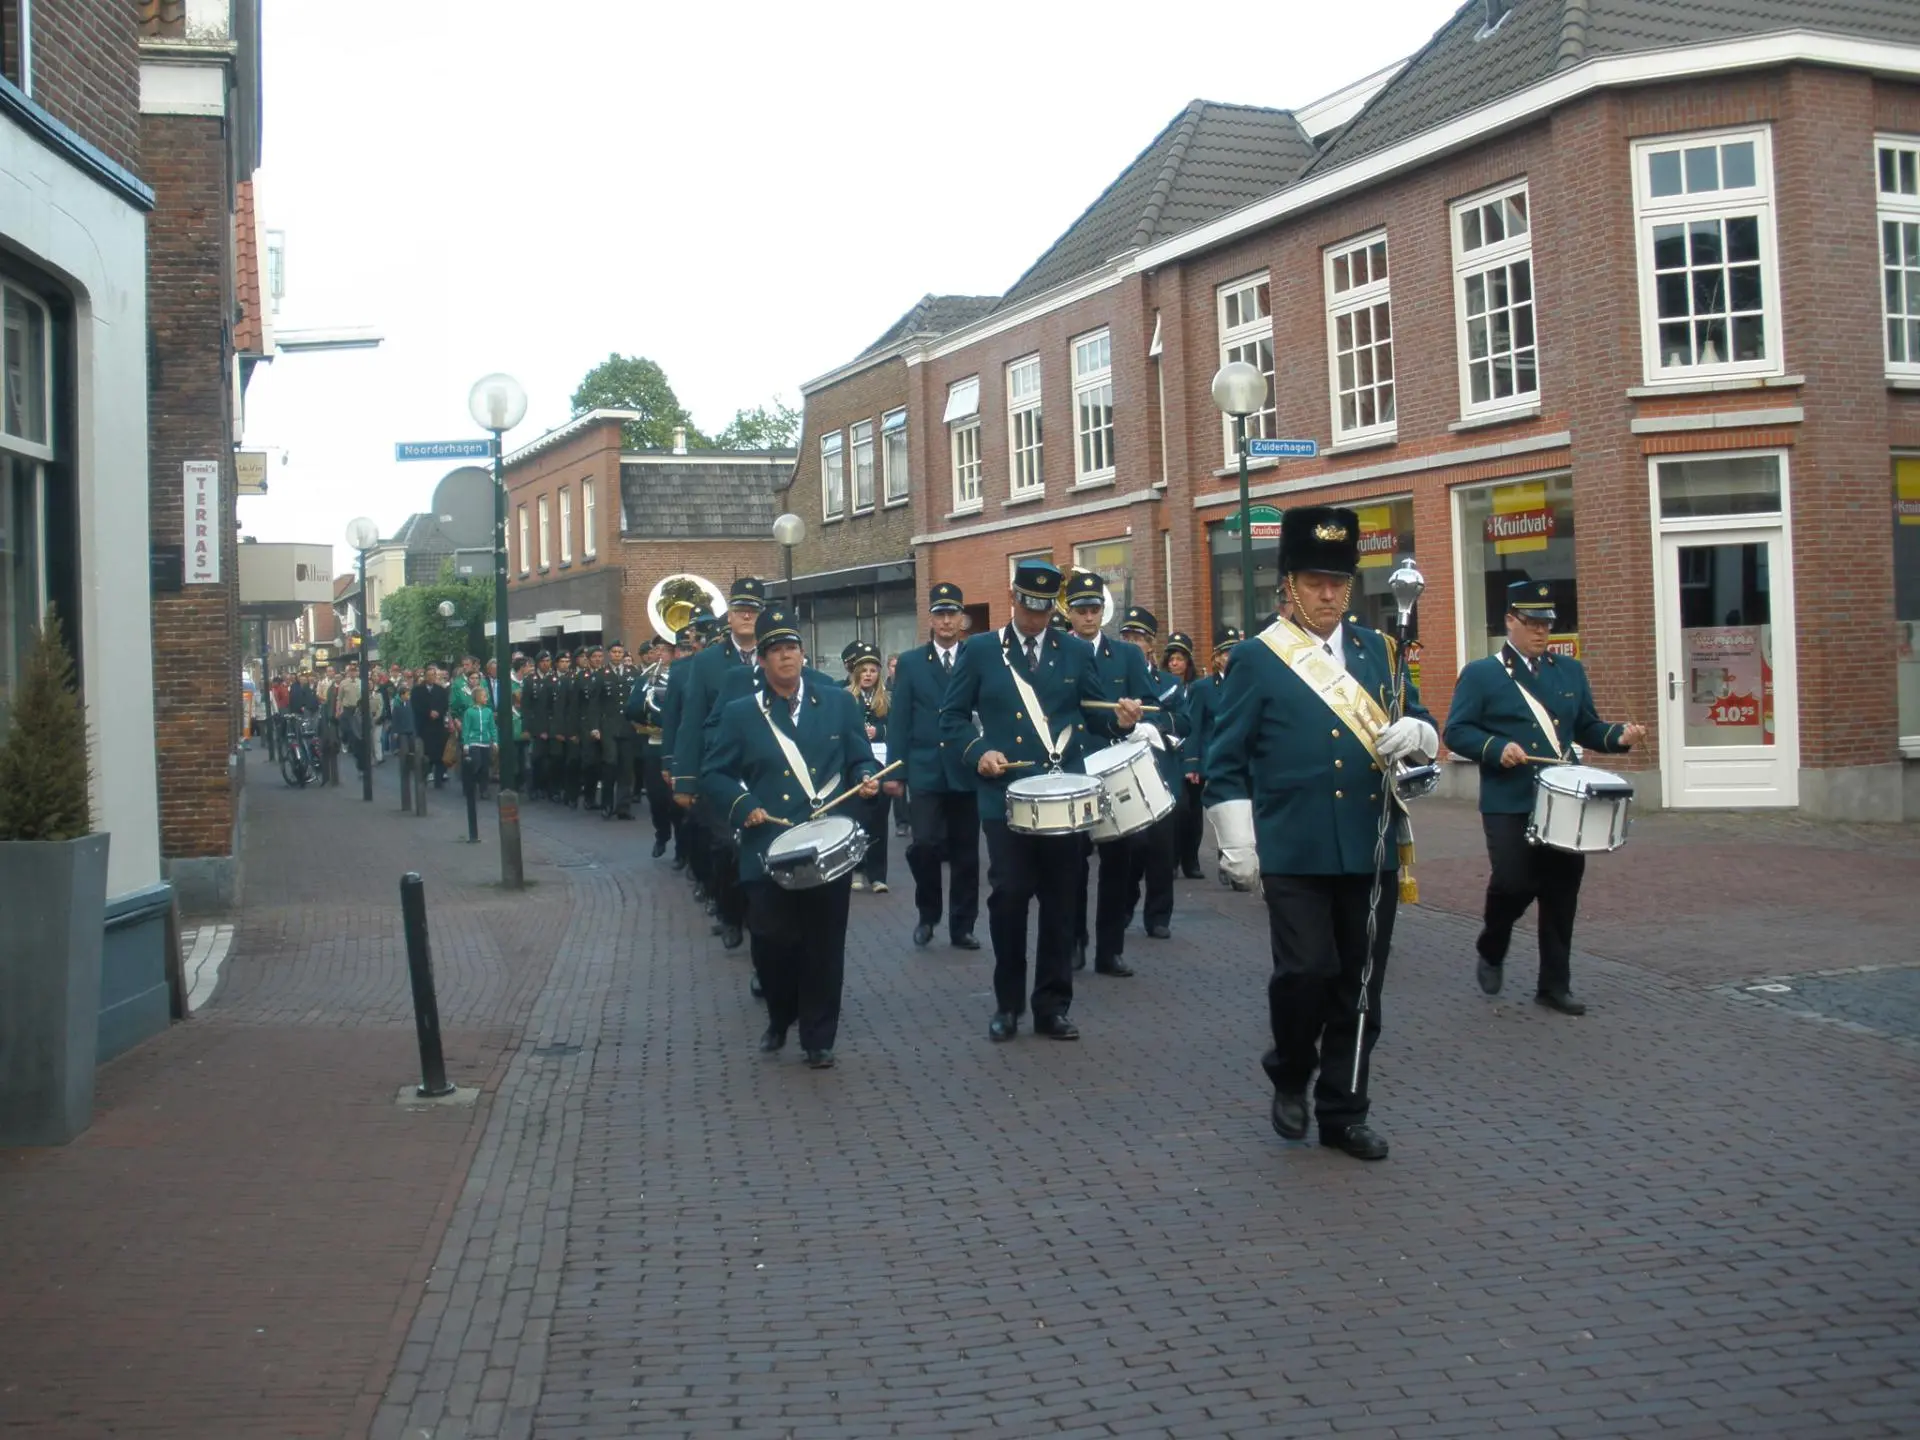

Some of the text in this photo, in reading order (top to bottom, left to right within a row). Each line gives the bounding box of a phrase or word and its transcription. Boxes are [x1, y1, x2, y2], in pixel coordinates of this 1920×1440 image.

[404, 444, 482, 456] Noorderhagen
[1254, 442, 1312, 453] Zuiderhagen
[195, 477, 208, 568] TERRAS
[1493, 513, 1548, 538] Kruidvat
[1251, 526, 1281, 536] Kruidva
[1357, 532, 1392, 552] ruidvat
[1547, 642, 1574, 657] CTIE!
